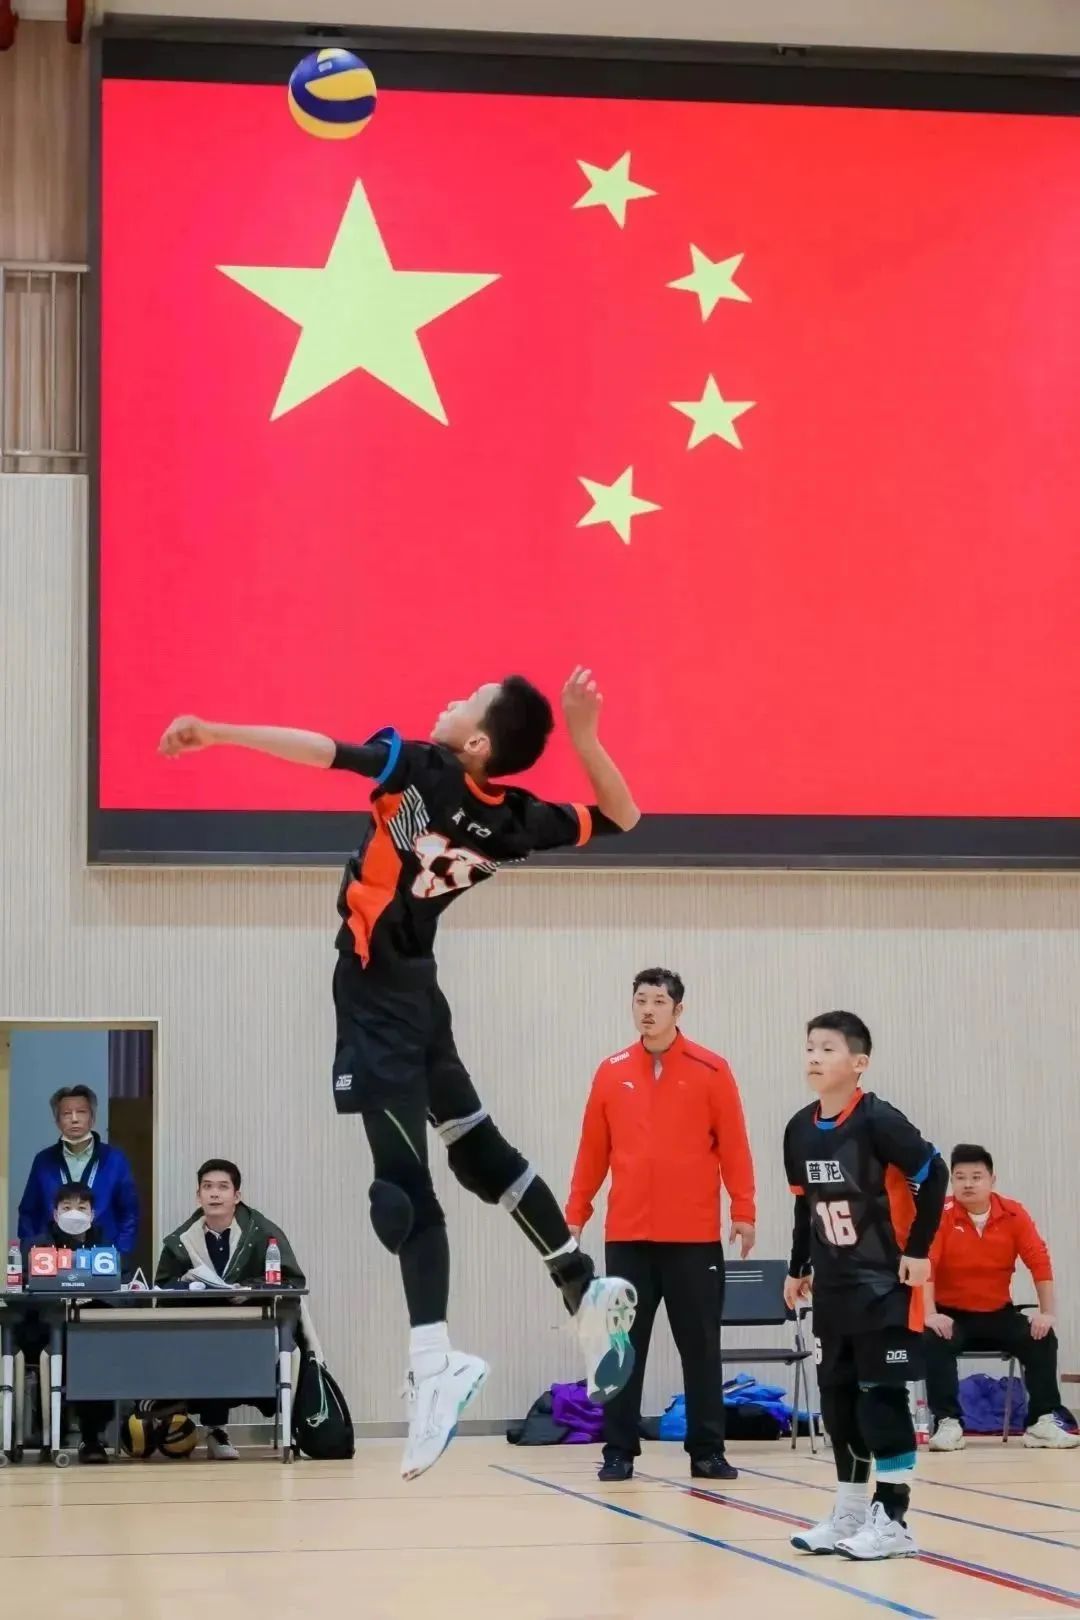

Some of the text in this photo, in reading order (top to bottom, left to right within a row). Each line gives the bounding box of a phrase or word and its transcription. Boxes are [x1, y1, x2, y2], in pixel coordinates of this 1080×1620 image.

[808, 1162, 843, 1182] 普陀
[816, 1200, 858, 1247] 16
[34, 1251, 115, 1274] 3 1 1 6
[886, 1350, 908, 1361] DOS
